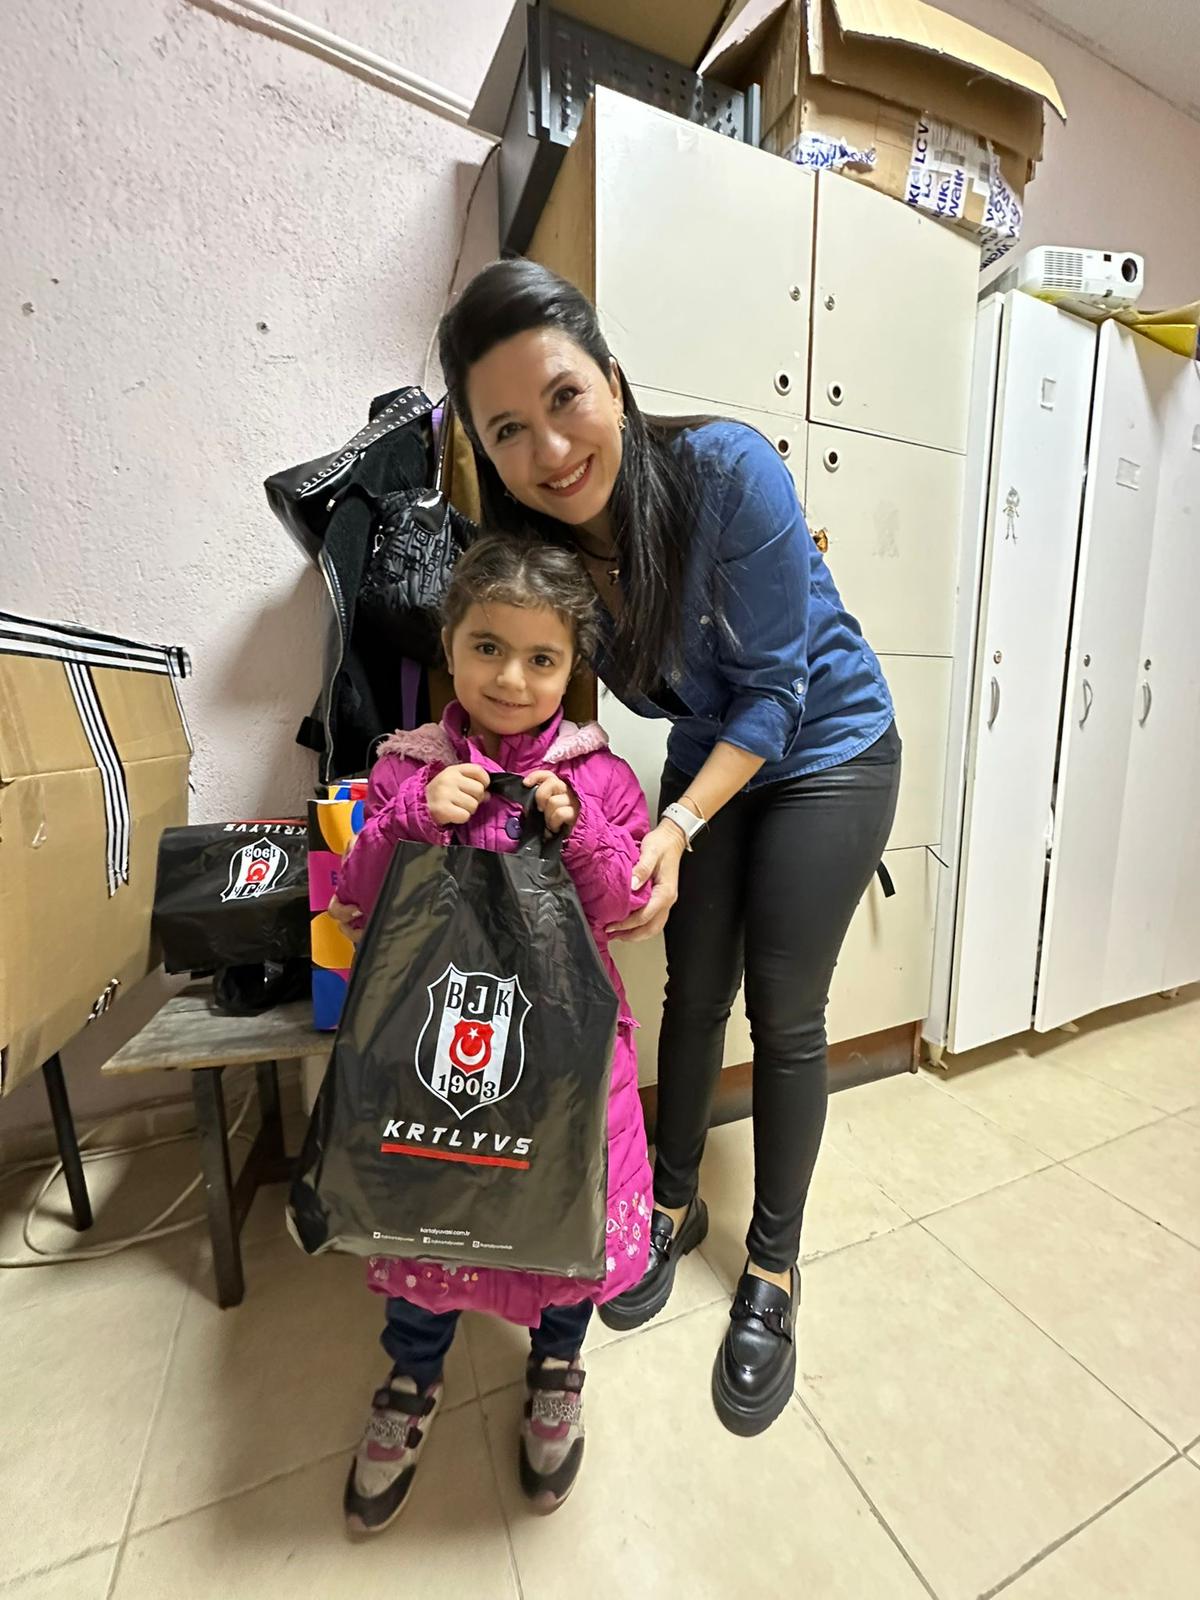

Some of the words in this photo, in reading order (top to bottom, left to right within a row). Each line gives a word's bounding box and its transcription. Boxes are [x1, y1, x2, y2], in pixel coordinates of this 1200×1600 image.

[223, 823, 307, 836] KRTLYVS
[244, 847, 277, 859] 1903
[446, 981, 512, 1018] BJK
[436, 1072, 497, 1099] 1903
[382, 1118, 534, 1156] KRTLYVS
